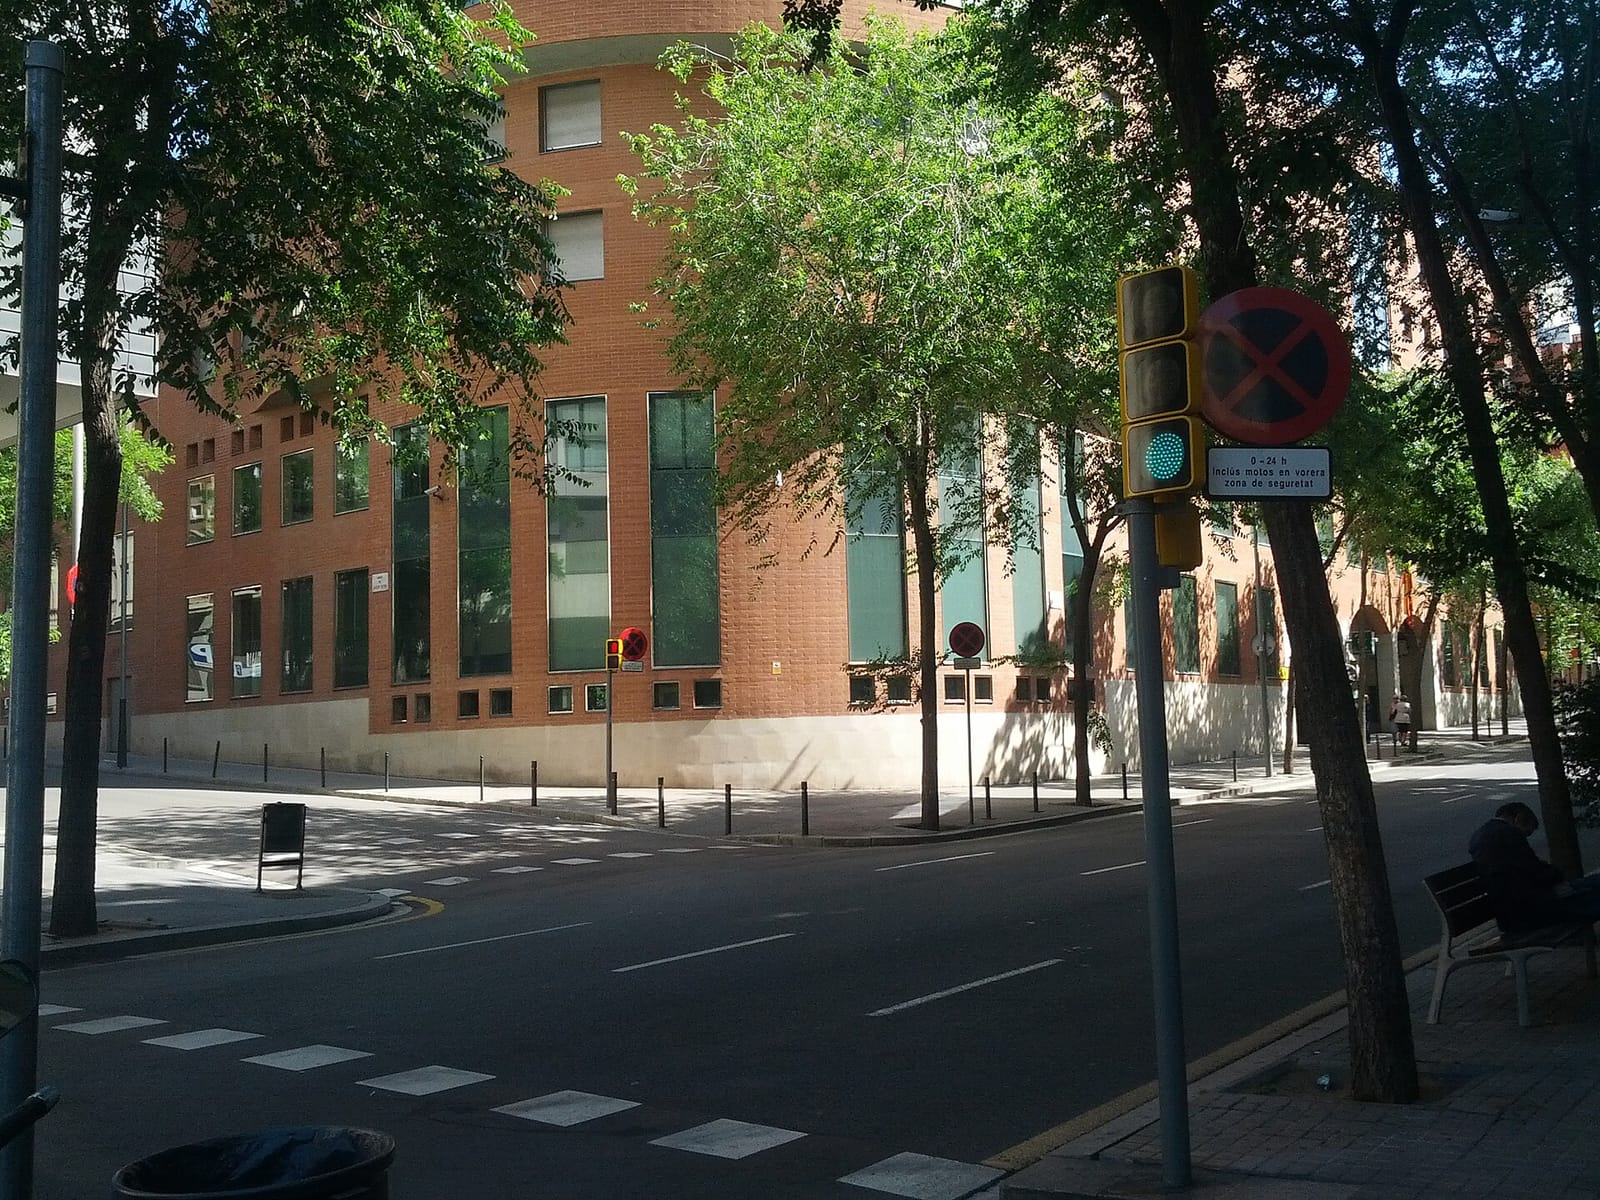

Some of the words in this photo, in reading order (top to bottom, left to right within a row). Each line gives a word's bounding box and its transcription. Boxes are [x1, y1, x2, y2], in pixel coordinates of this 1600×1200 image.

[1281, 456, 1287, 465] h
[1212, 466, 1240, 476] Inclús
[1245, 468, 1274, 476] motos
[1251, 478, 1263, 487] de
[1268, 480, 1313, 489] seguretat
